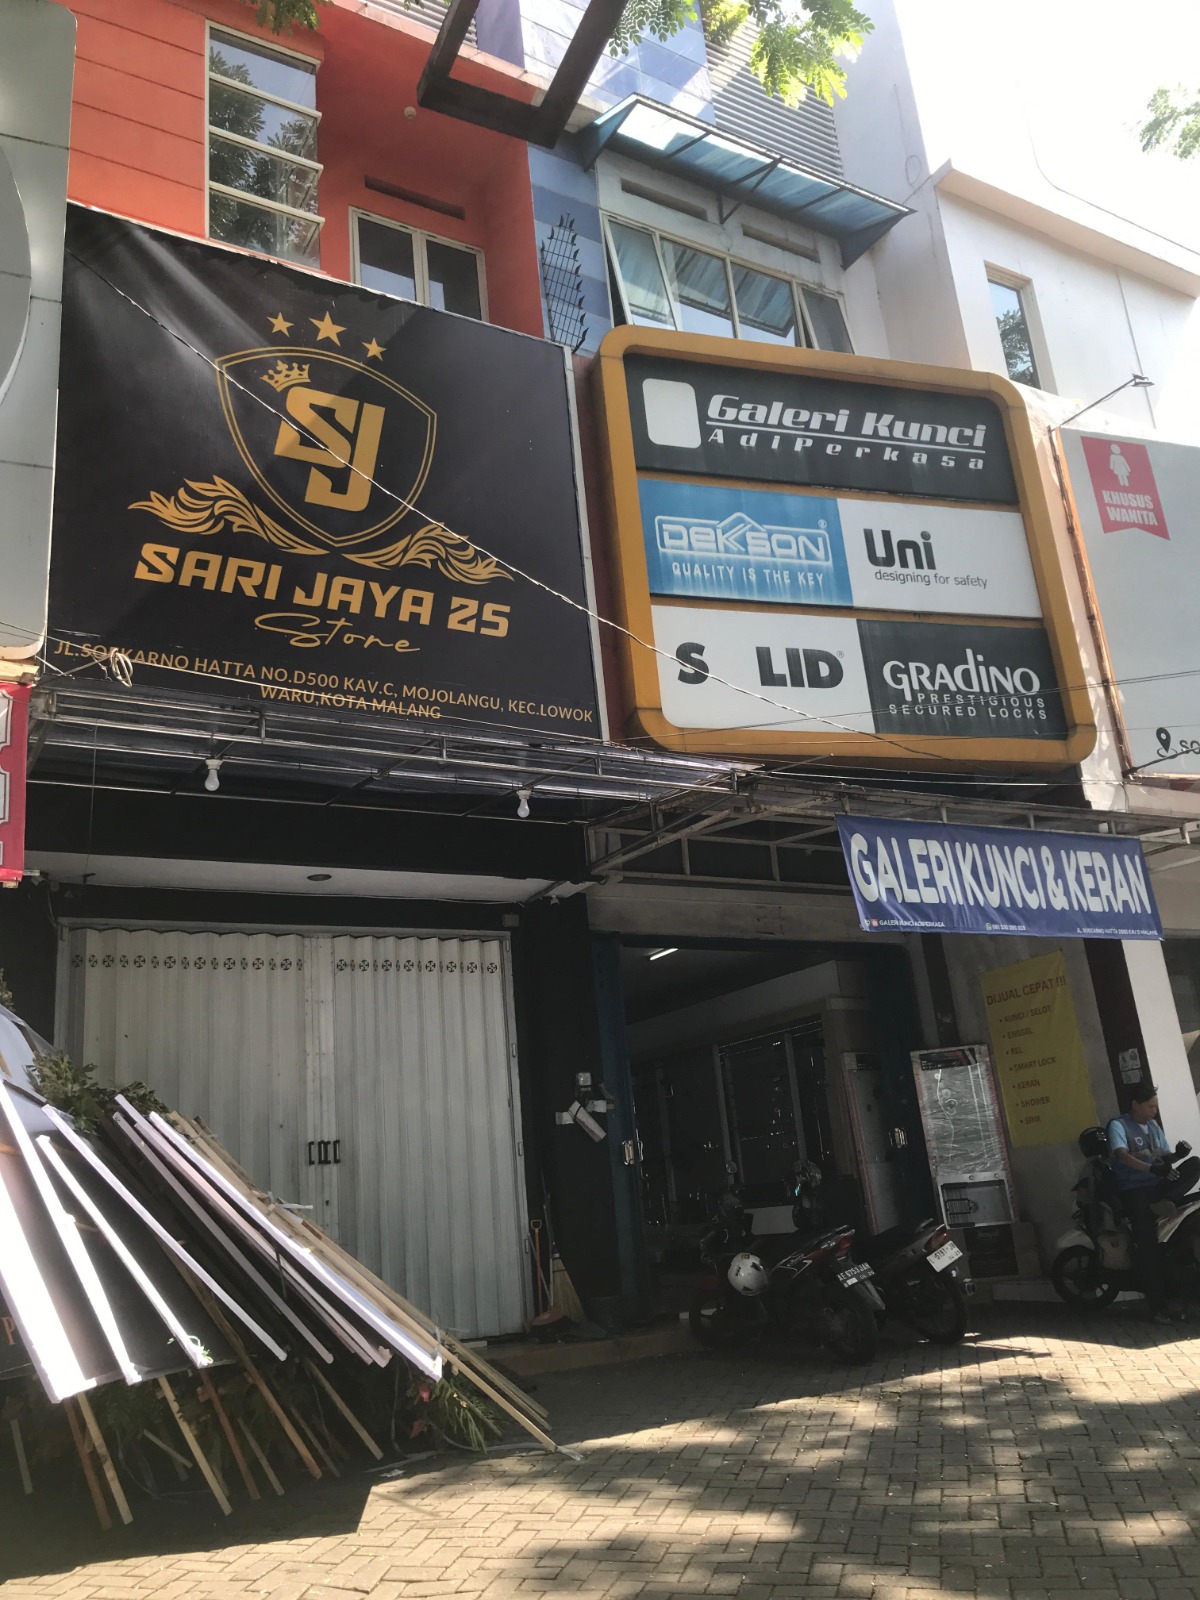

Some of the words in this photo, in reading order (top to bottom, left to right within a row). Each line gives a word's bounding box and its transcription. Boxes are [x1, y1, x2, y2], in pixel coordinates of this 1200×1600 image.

[707, 394, 850, 432] Galeri
[860, 412, 987, 447] Kunci
[1102, 490, 1154, 509] KHUSUS
[1106, 506, 1158, 526] WANITA
[863, 528, 937, 571] Uni
[671, 561, 734, 580] QUALITY
[743, 567, 756, 581] IS
[763, 569, 791, 585] THE
[797, 571, 825, 587] KEY
[874, 569, 931, 586] designing
[933, 572, 950, 585] for
[953, 576, 988, 590] safety
[134, 543, 283, 601] SARI
[292, 572, 435, 626] JAYA
[447, 596, 512, 638] 25
[254, 612, 421, 653] Store
[194, 658, 255, 678] HATTA
[260, 666, 339, 689] NO.D500
[343, 677, 398, 698] KAV.C,
[402, 685, 505, 713] MOJOLANGU,
[508, 699, 593, 722] KEC.LOWOK
[372, 700, 441, 719] MALANG
[917, 693, 1045, 708] PRESTIGIOUS
[888, 703, 977, 717] SECURED
[988, 708, 1047, 720] LOCKS
[1061, 849, 1151, 914] KERAN
[986, 988, 1021, 1006] DIJUAL
[1023, 978, 1054, 996] CEPAT
[1030, 1005, 1052, 1018] SELOT
[1013, 1059, 1037, 1073] SMART
[1038, 1056, 1057, 1069] LOCK
[1017, 1079, 1040, 1091] KERAN
[1020, 1096, 1051, 1108] SHOWER
